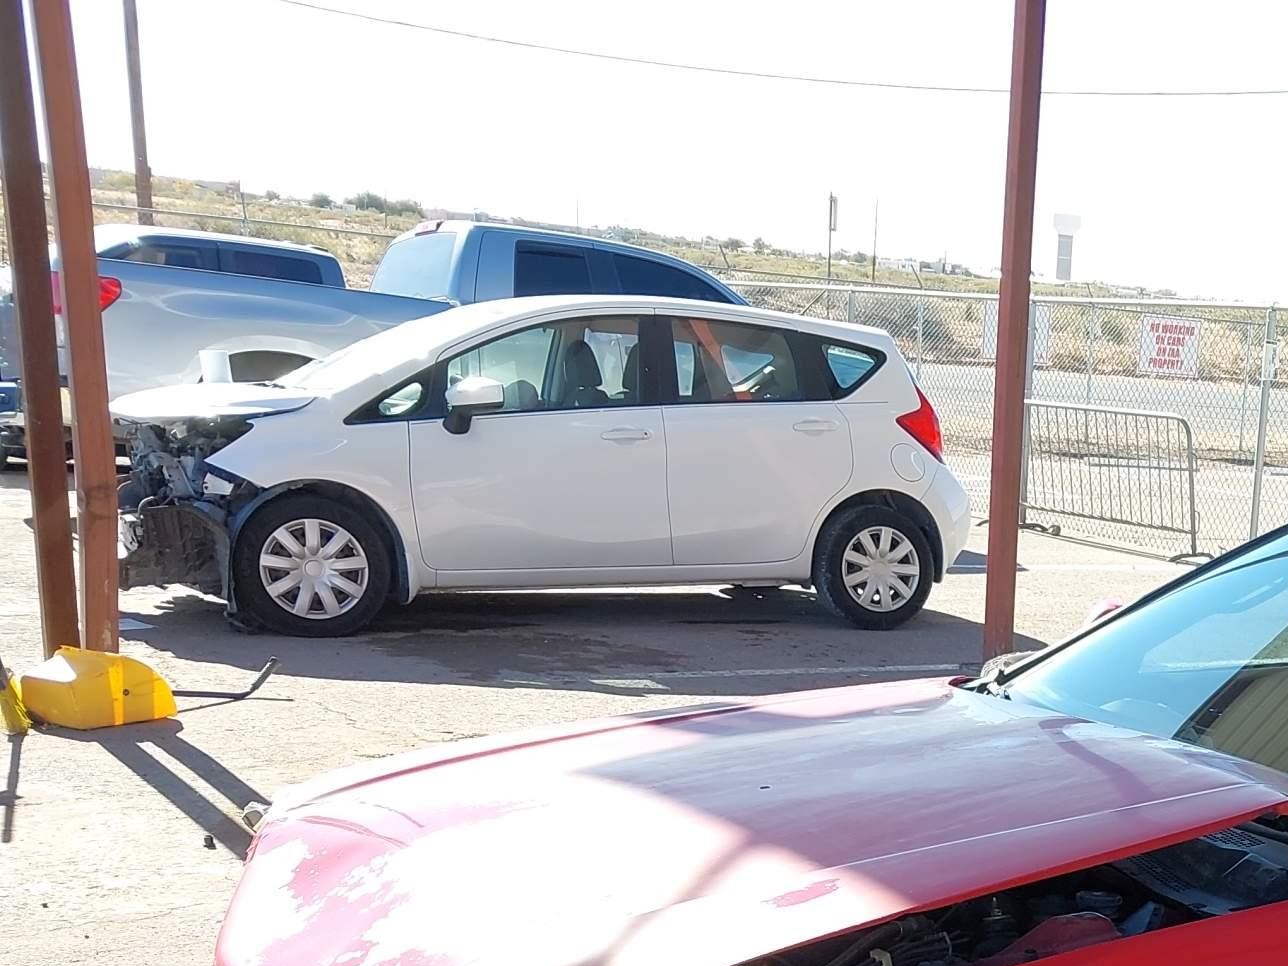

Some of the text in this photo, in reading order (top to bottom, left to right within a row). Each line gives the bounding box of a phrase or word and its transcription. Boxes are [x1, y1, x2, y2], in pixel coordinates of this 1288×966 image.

[1150, 322, 1196, 337] NO WORKING
[1155, 334, 1186, 347] ON CARS
[1156, 346, 1180, 358] ON IAA
[1148, 357, 1185, 370] PROPERTY
